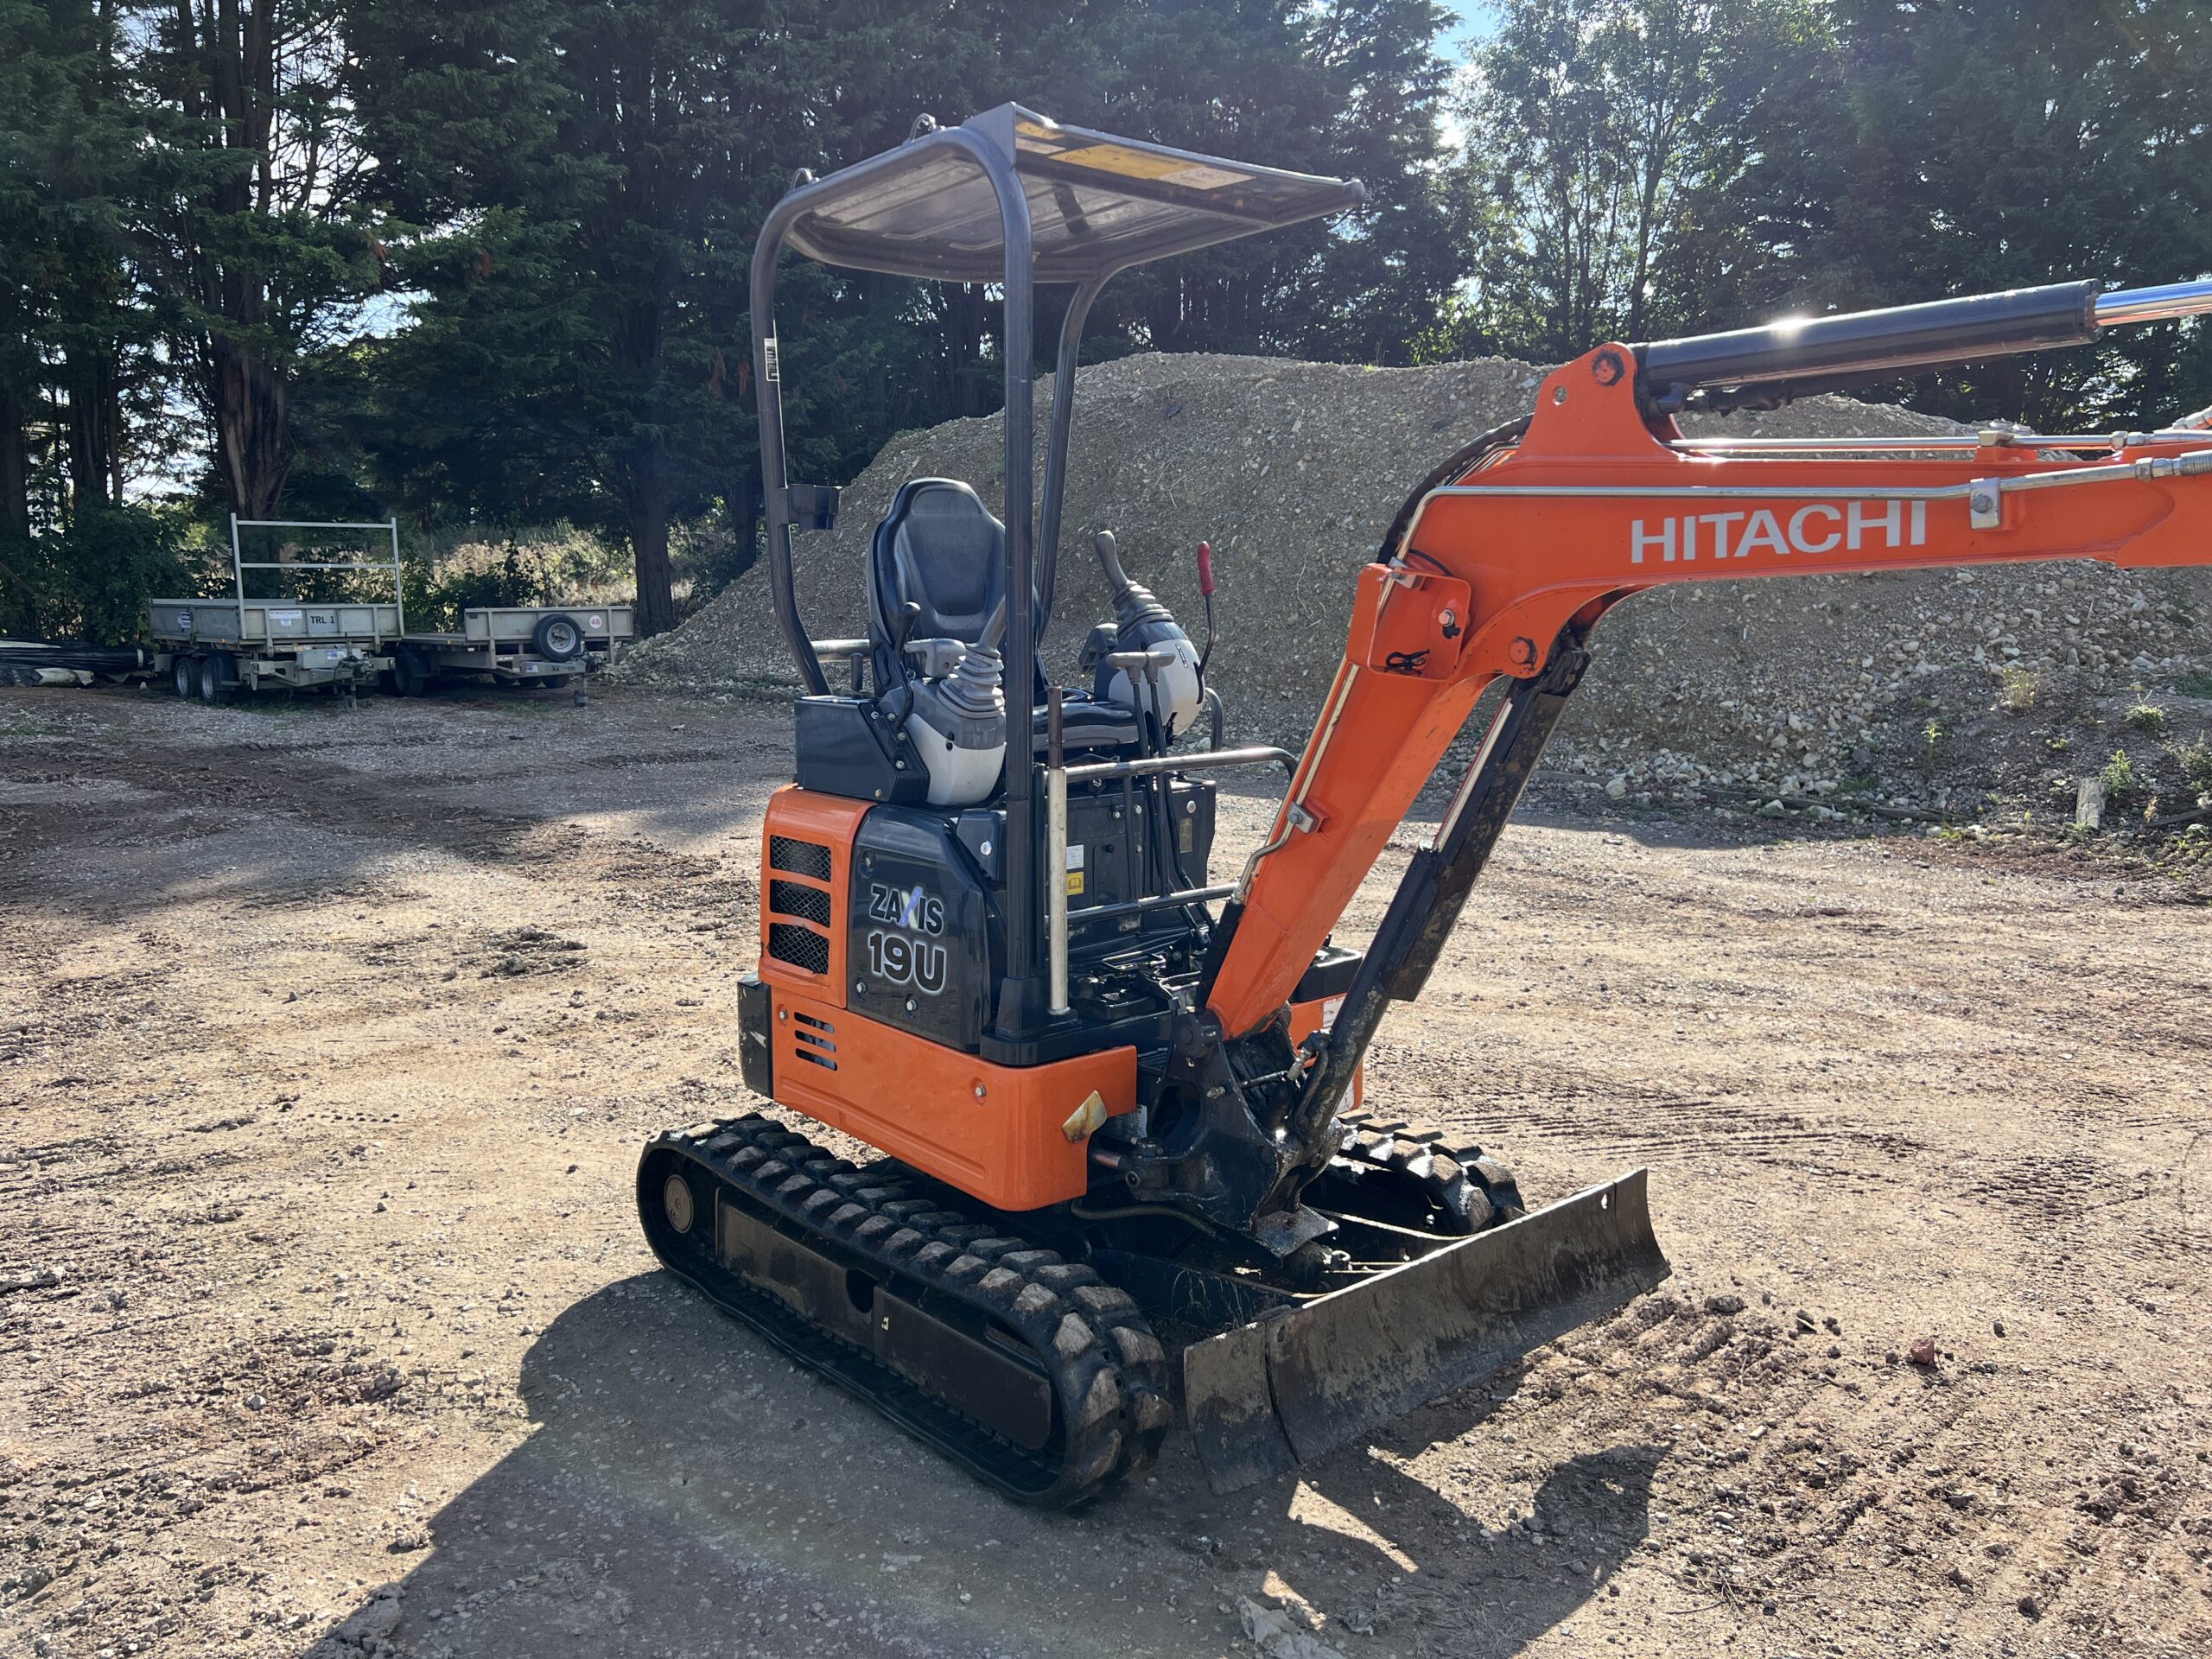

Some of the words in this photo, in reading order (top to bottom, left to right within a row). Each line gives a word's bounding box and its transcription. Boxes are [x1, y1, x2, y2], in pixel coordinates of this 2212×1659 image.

[1631, 500, 1926, 563] HITACHI
[310, 615, 327, 624] TRL
[330, 615, 335, 624] 1
[870, 884, 944, 935] ZAXIS
[868, 931, 947, 994] 19U
